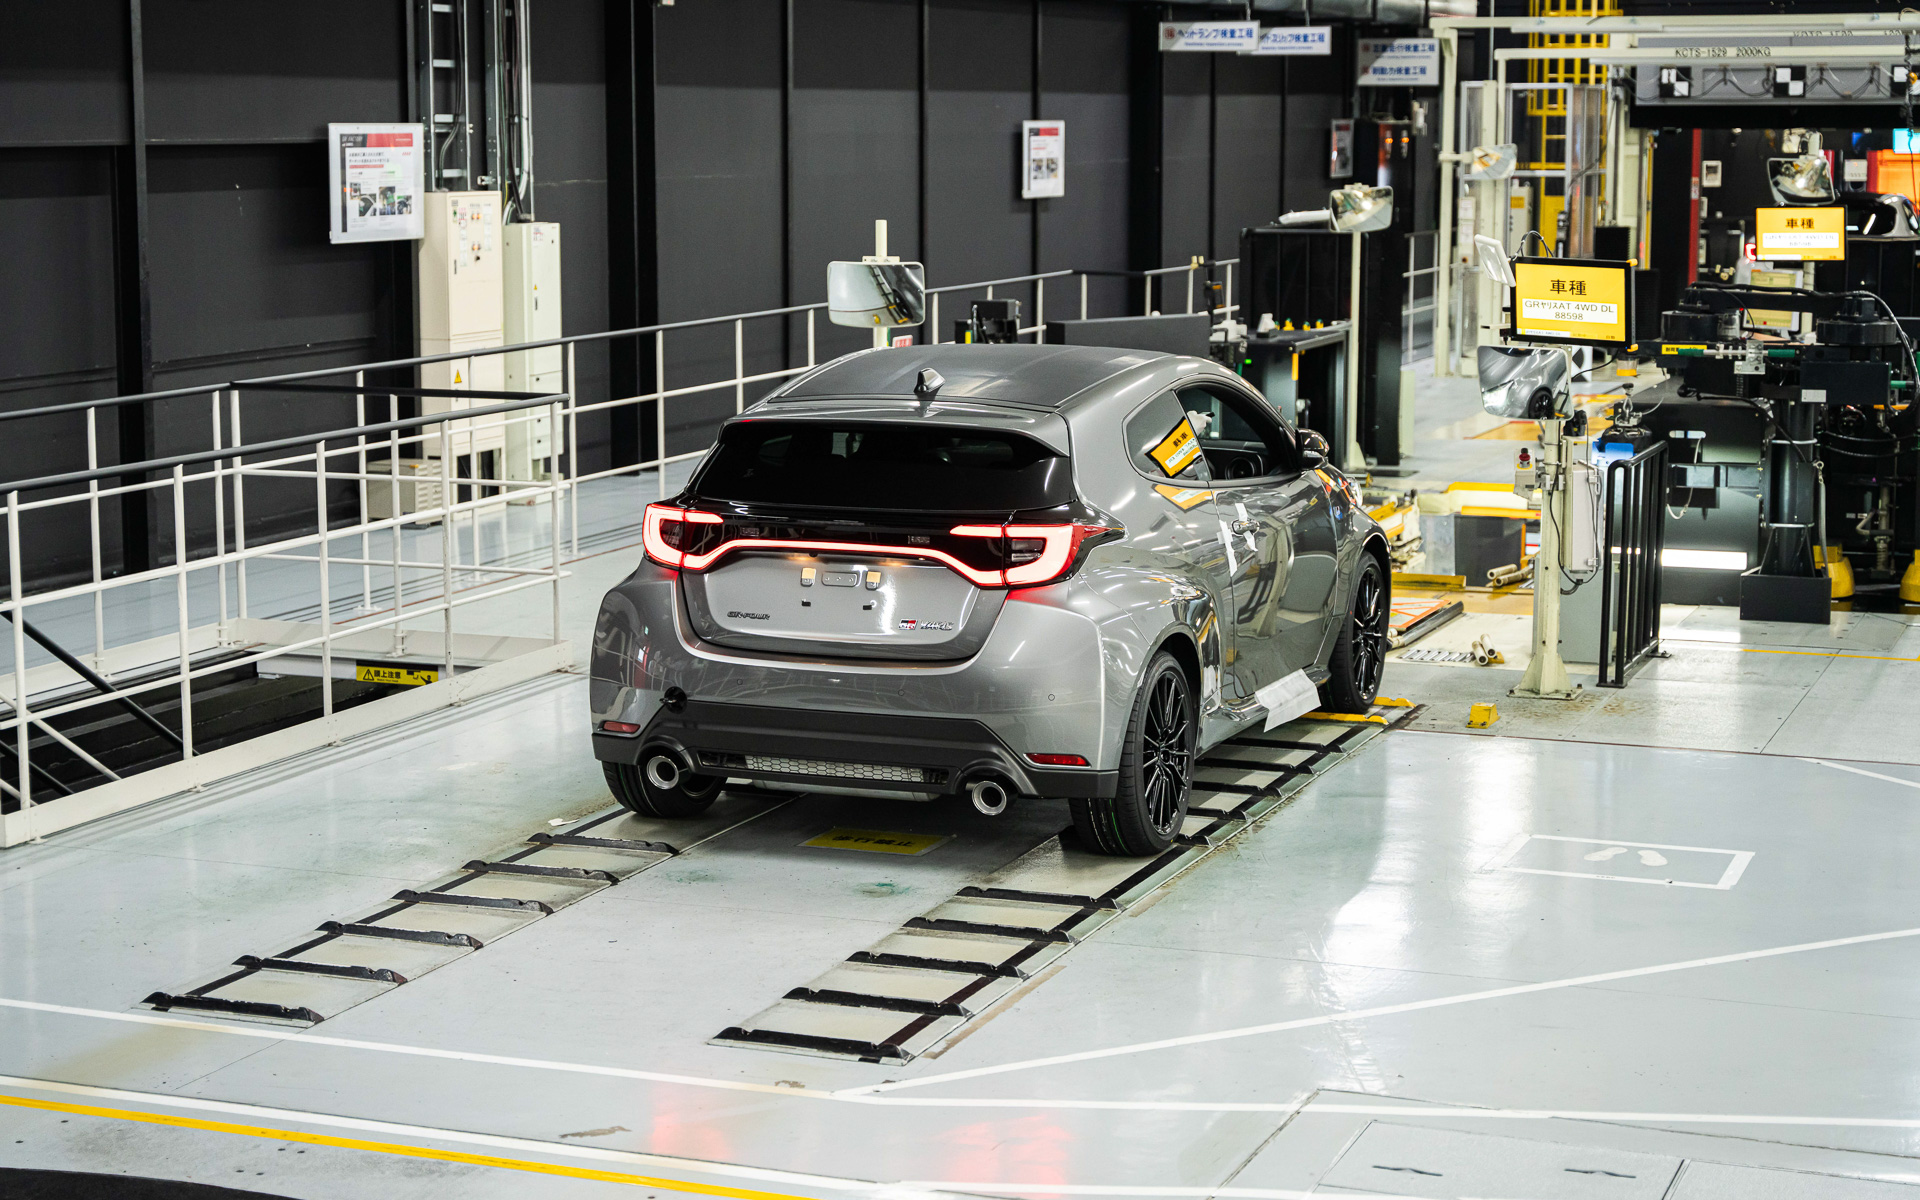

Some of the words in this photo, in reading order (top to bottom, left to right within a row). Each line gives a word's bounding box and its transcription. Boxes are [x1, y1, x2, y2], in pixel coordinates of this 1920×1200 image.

[1675, 47, 1727, 58] KCTS-1529
[1736, 47, 1771, 57] 2000KG
[1786, 217, 1815, 229] 車種
[1550, 279, 1587, 296] 車種
[1524, 300, 1572, 311] GRヤリスAT
[1574, 303, 1598, 313] 4WD
[1600, 304, 1615, 314] DL
[1554, 311, 1584, 321] 88598
[374, 670, 400, 679] 頭上注意
